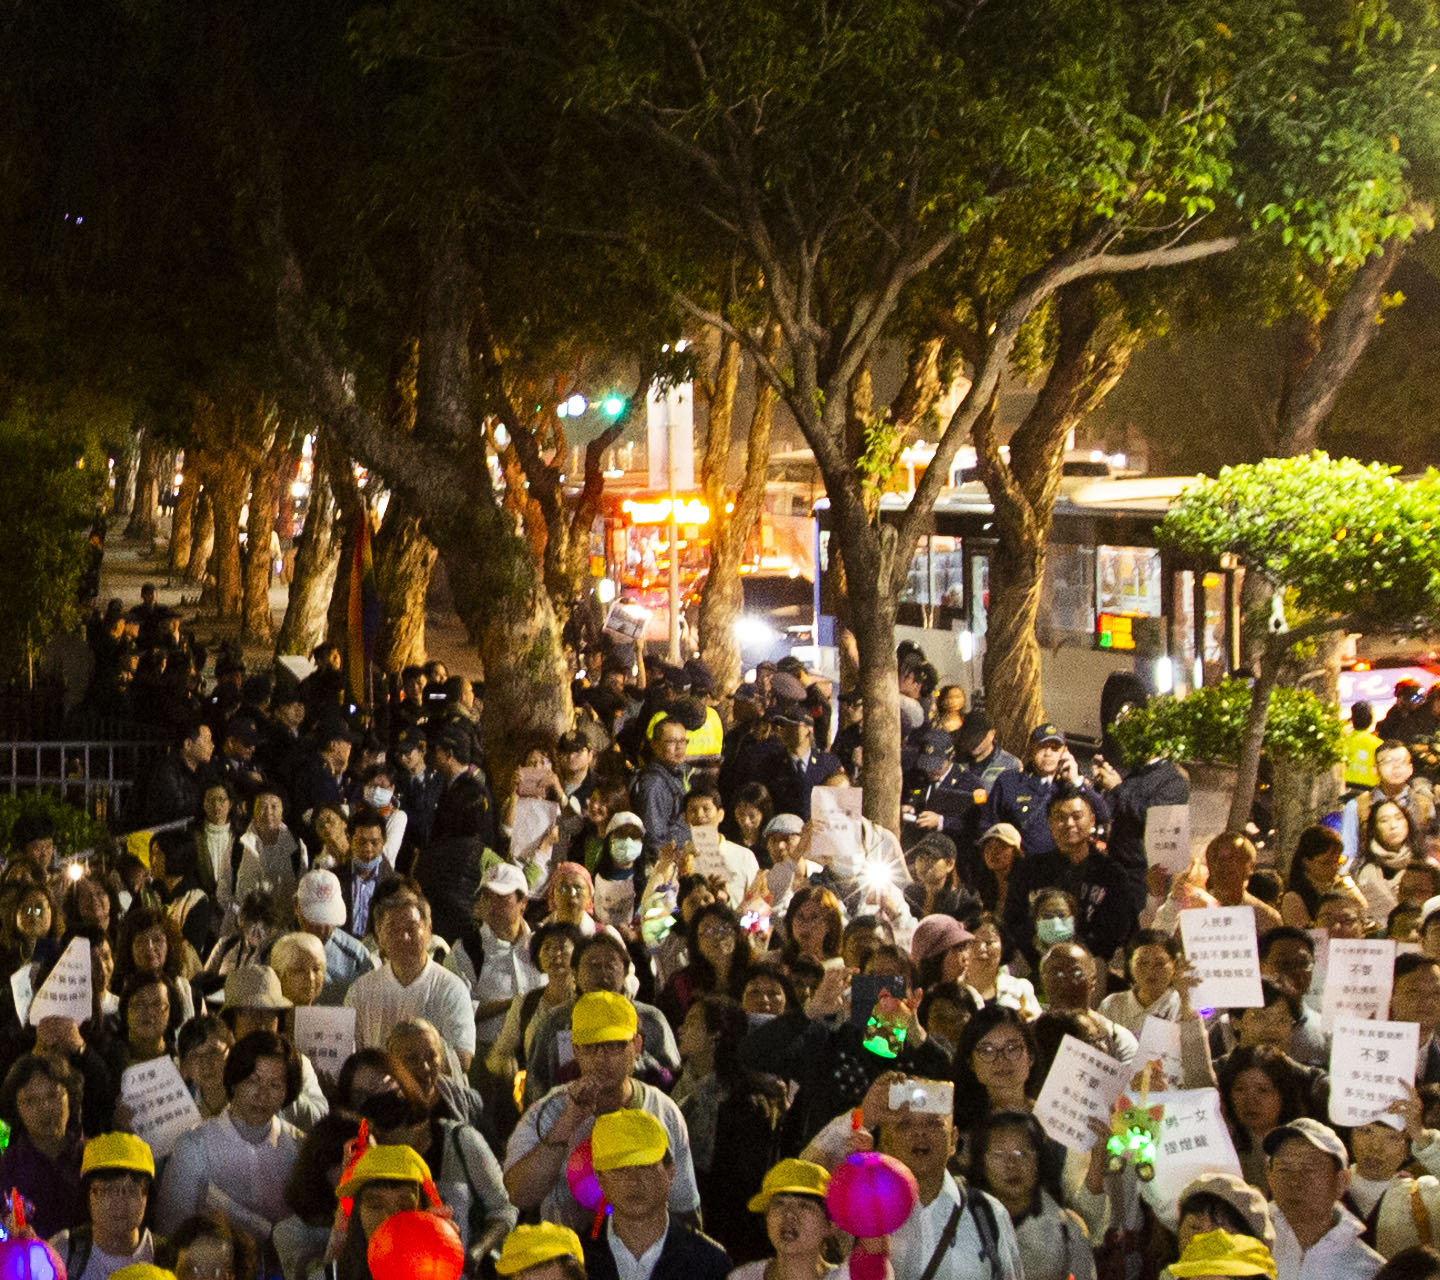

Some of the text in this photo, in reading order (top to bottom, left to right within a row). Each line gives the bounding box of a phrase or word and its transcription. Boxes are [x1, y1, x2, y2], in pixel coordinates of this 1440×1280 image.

[1201, 917, 1232, 927] 人民要
[1350, 964, 1373, 975] 不要
[1360, 1048, 1391, 1064] 不要
[1078, 1070, 1100, 1090] 不要
